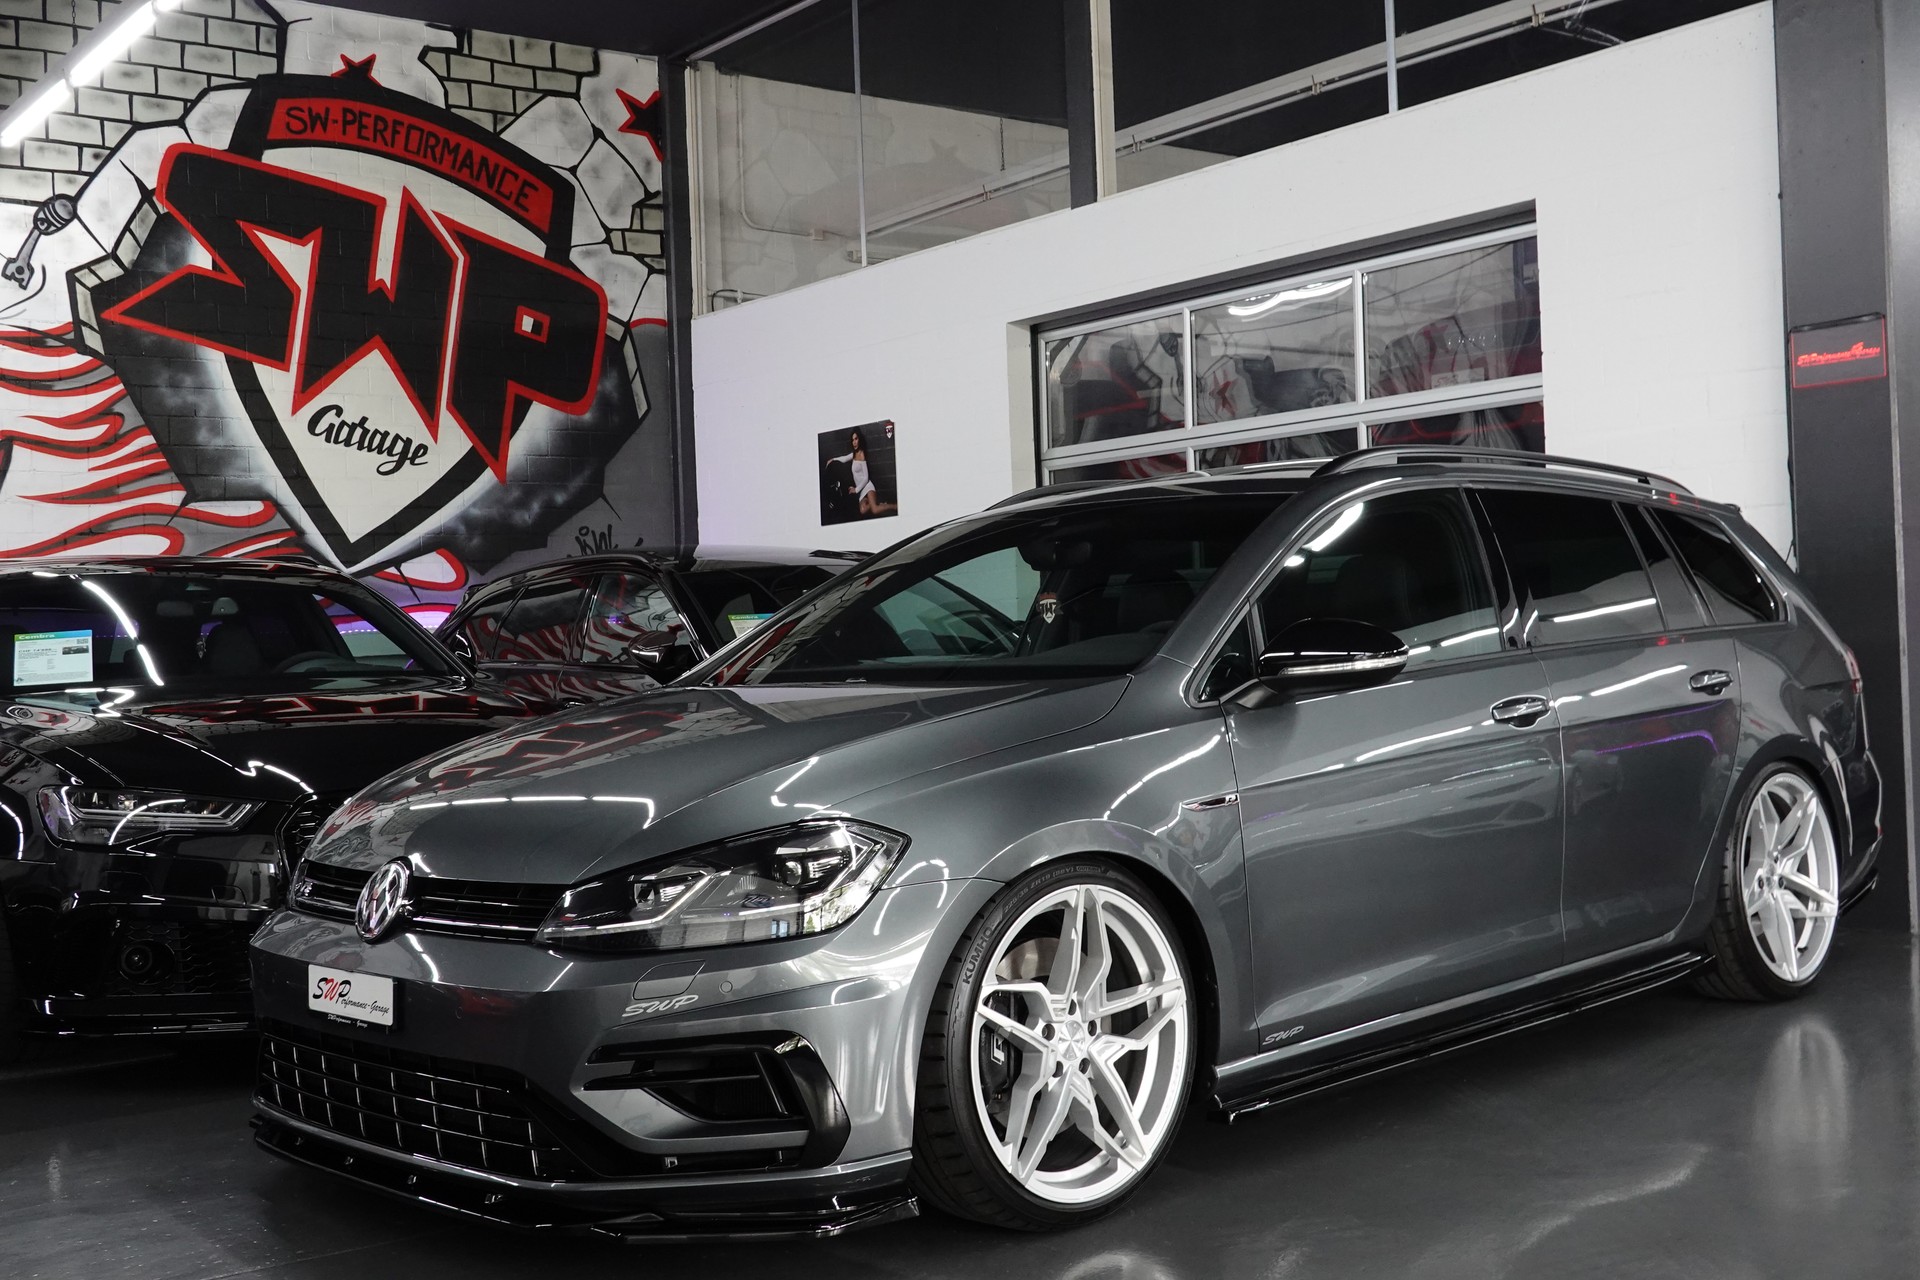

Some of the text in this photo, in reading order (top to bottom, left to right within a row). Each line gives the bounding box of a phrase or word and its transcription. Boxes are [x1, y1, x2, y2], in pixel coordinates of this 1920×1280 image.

[285, 106, 539, 213] SW-PERFORMANCE
[102, 142, 609, 486] SWP
[307, 404, 429, 476] Garage
[962, 926, 994, 985] KUMHO
[621, 994, 699, 1018] SWP
[1262, 1025, 1305, 1046] SWP
